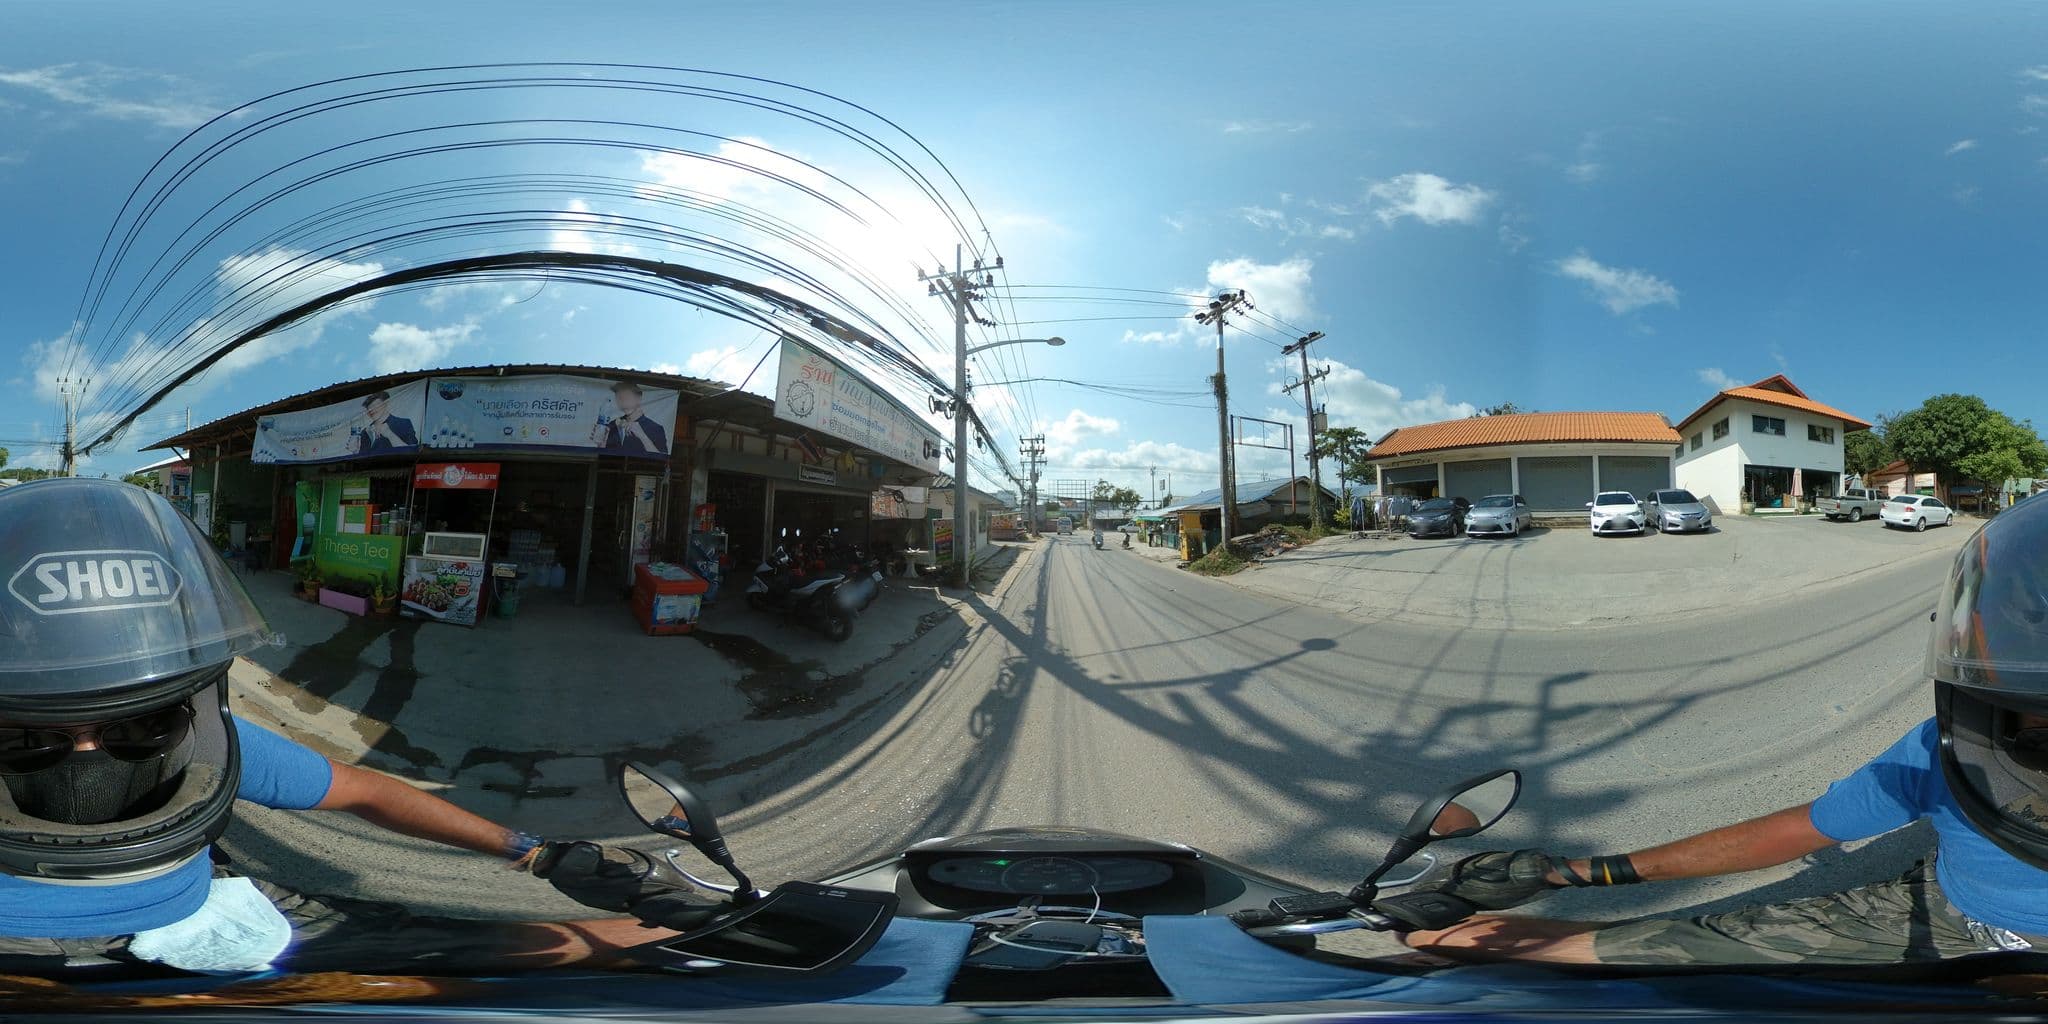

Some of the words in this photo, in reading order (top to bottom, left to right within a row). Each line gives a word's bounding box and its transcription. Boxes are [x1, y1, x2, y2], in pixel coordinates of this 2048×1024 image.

[324, 537, 359, 555] Three
[362, 542, 389, 559] Tea
[35, 559, 170, 603] SHOEI
